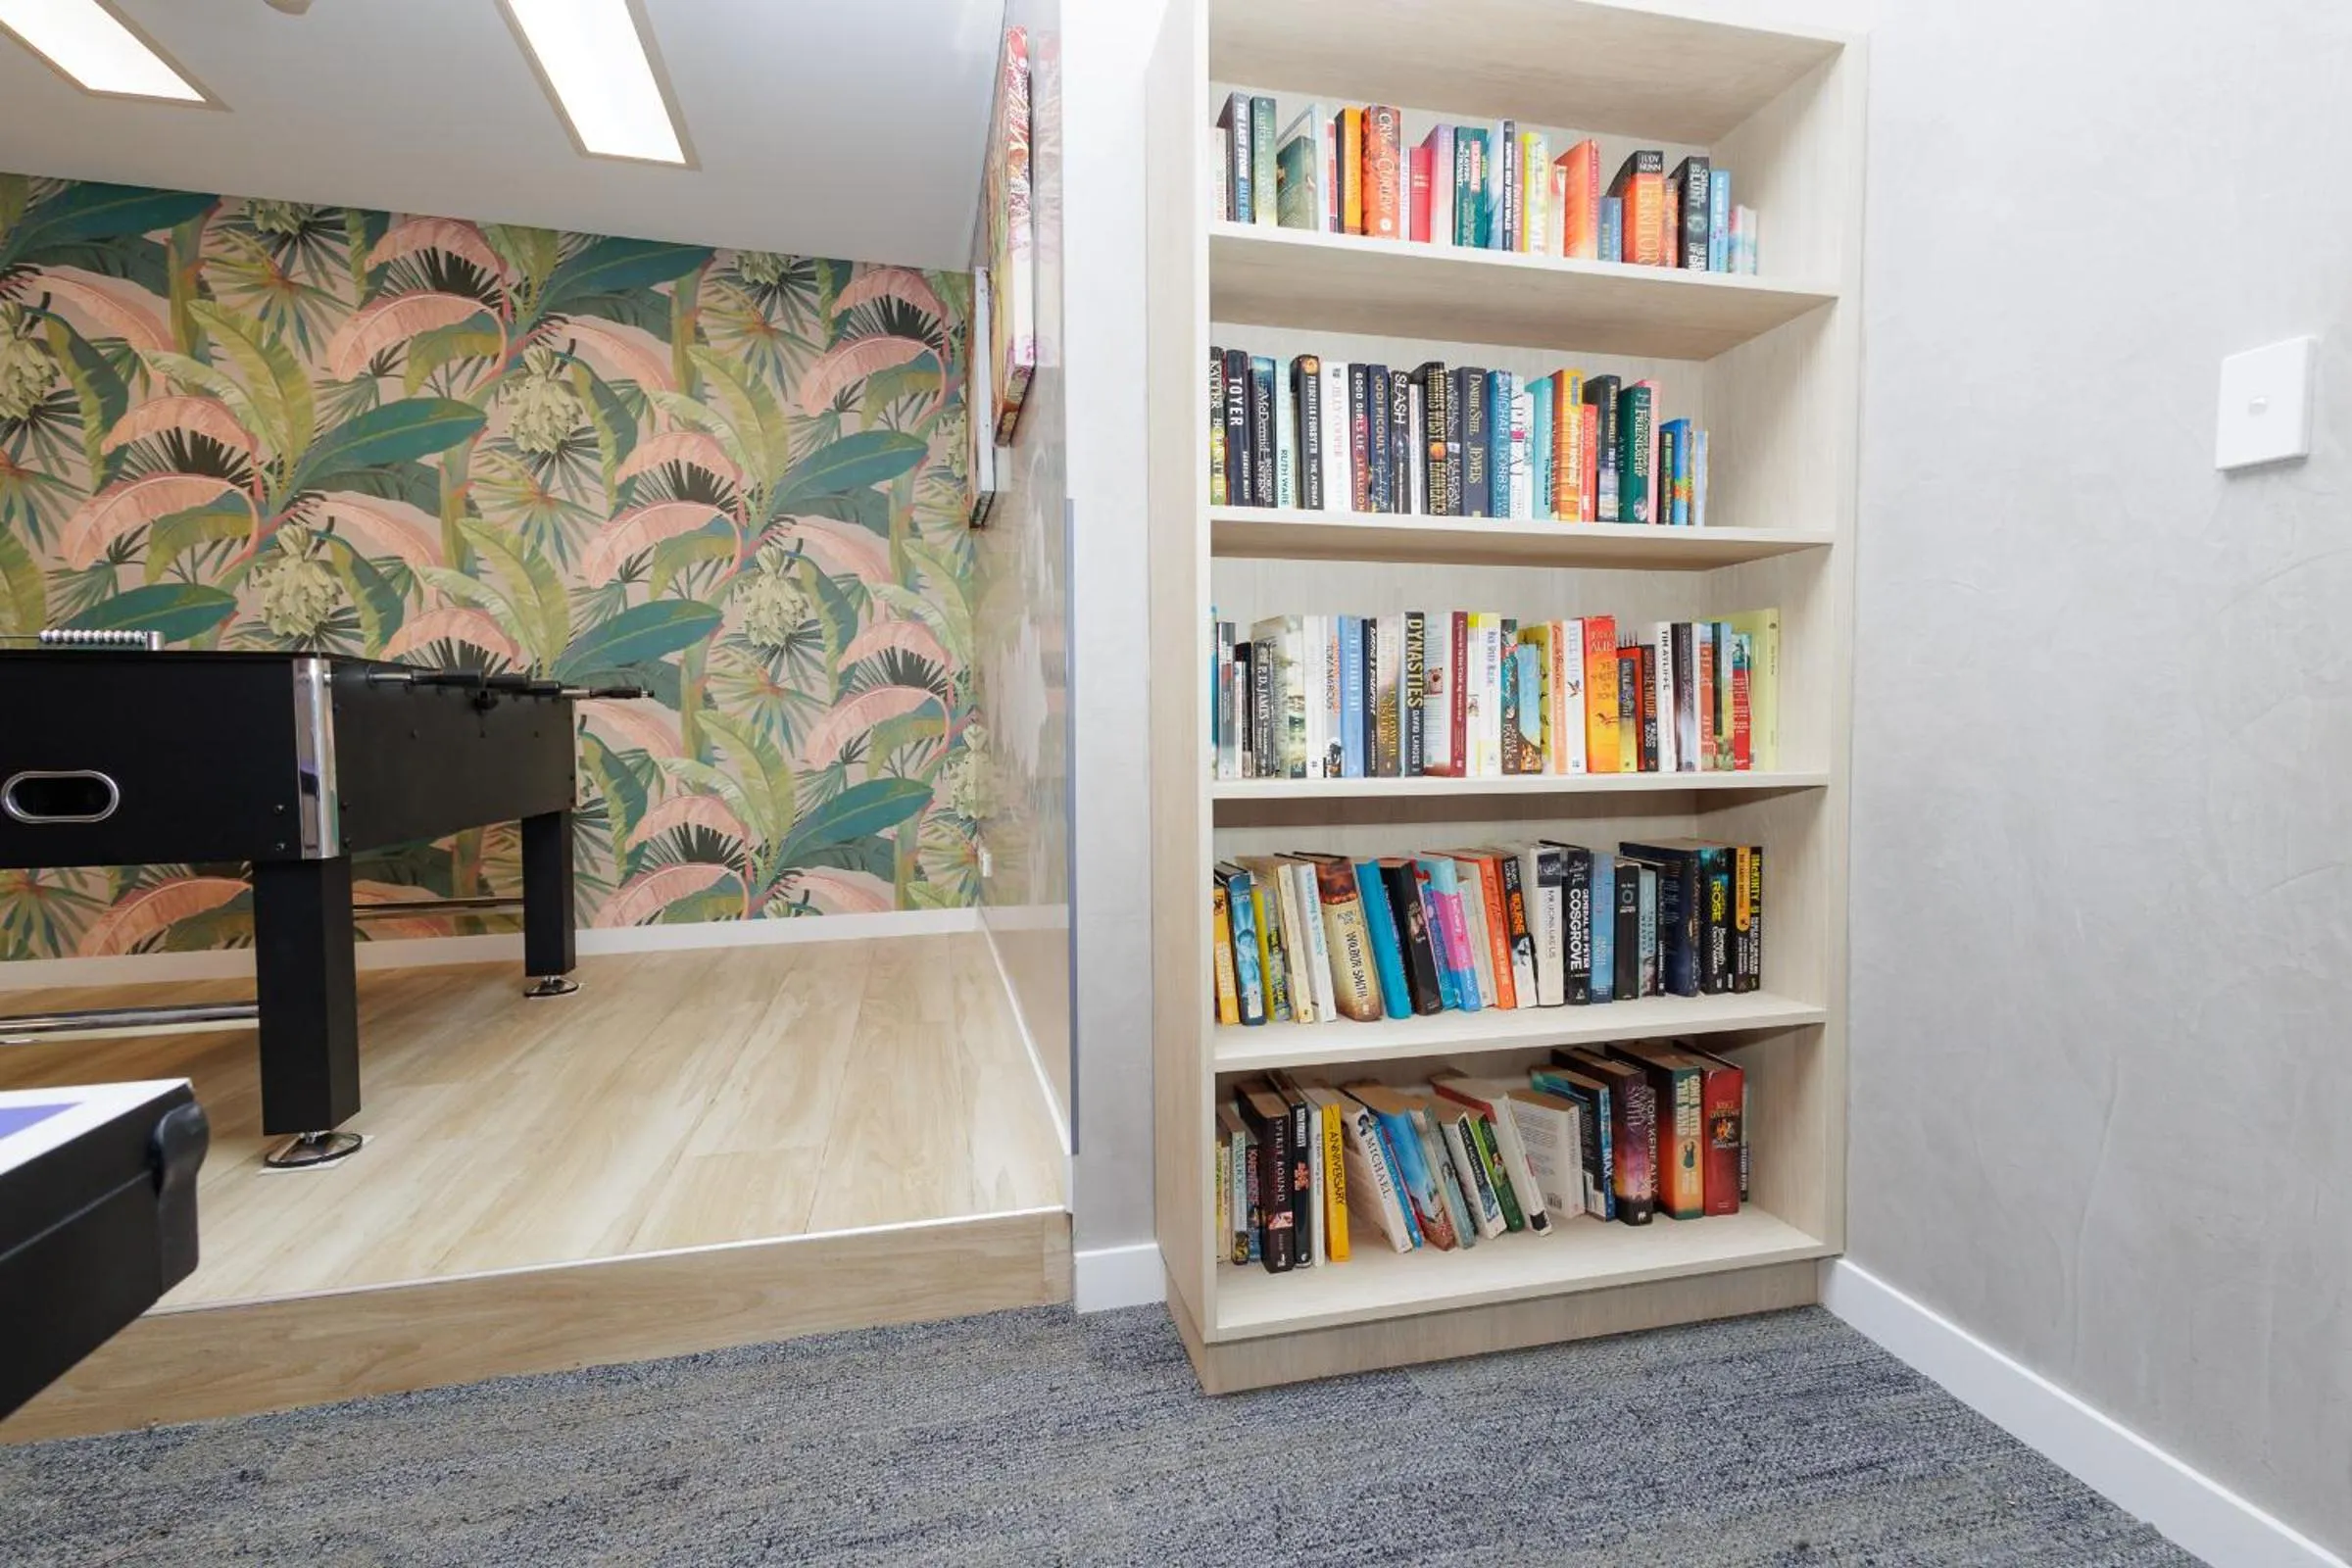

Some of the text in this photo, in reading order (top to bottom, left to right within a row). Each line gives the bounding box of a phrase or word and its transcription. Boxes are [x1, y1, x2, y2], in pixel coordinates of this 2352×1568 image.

[1640, 163, 1661, 172] NUNN
[1690, 164, 1701, 209] BLUNT
[1229, 377, 1244, 426] TOYER
[1355, 402, 1364, 431] GIRLS
[1375, 375, 1385, 455] JODI PICOULT
[1395, 373, 1407, 424] SLASH
[1428, 369, 1446, 441] MORRIS WEST
[1308, 416, 1317, 454] FORSYTH
[1634, 409, 1647, 477] FRIENDSHIP
[1467, 442, 1484, 484] JEWELS
[1497, 447, 1509, 492] DOBBS
[1356, 471, 1365, 511] ELLISON
[1406, 618, 1423, 709] DYNASTIES
[1256, 688, 1270, 720] JAMES
[1645, 674, 1655, 719] SEYMOUR
[1712, 881, 1721, 922] ROSE
[1750, 860, 1759, 901] McKINTY
[1511, 893, 1525, 936] BOURNE
[1570, 889, 1582, 970] COSGROVE
[1345, 932, 1368, 998] WILBUR SMITH
[1275, 1119, 1284, 1155] SPIRIT
[1677, 1105, 1689, 1135] WIND
[1690, 1107, 1699, 1137] WITH
[1331, 1132, 1346, 1204] ANNIVERSARY
[1603, 1148, 1613, 1178] MAX
[1646, 1097, 1657, 1194] TOM KENEALLY
[1365, 1137, 1392, 1200] MICHAEL
